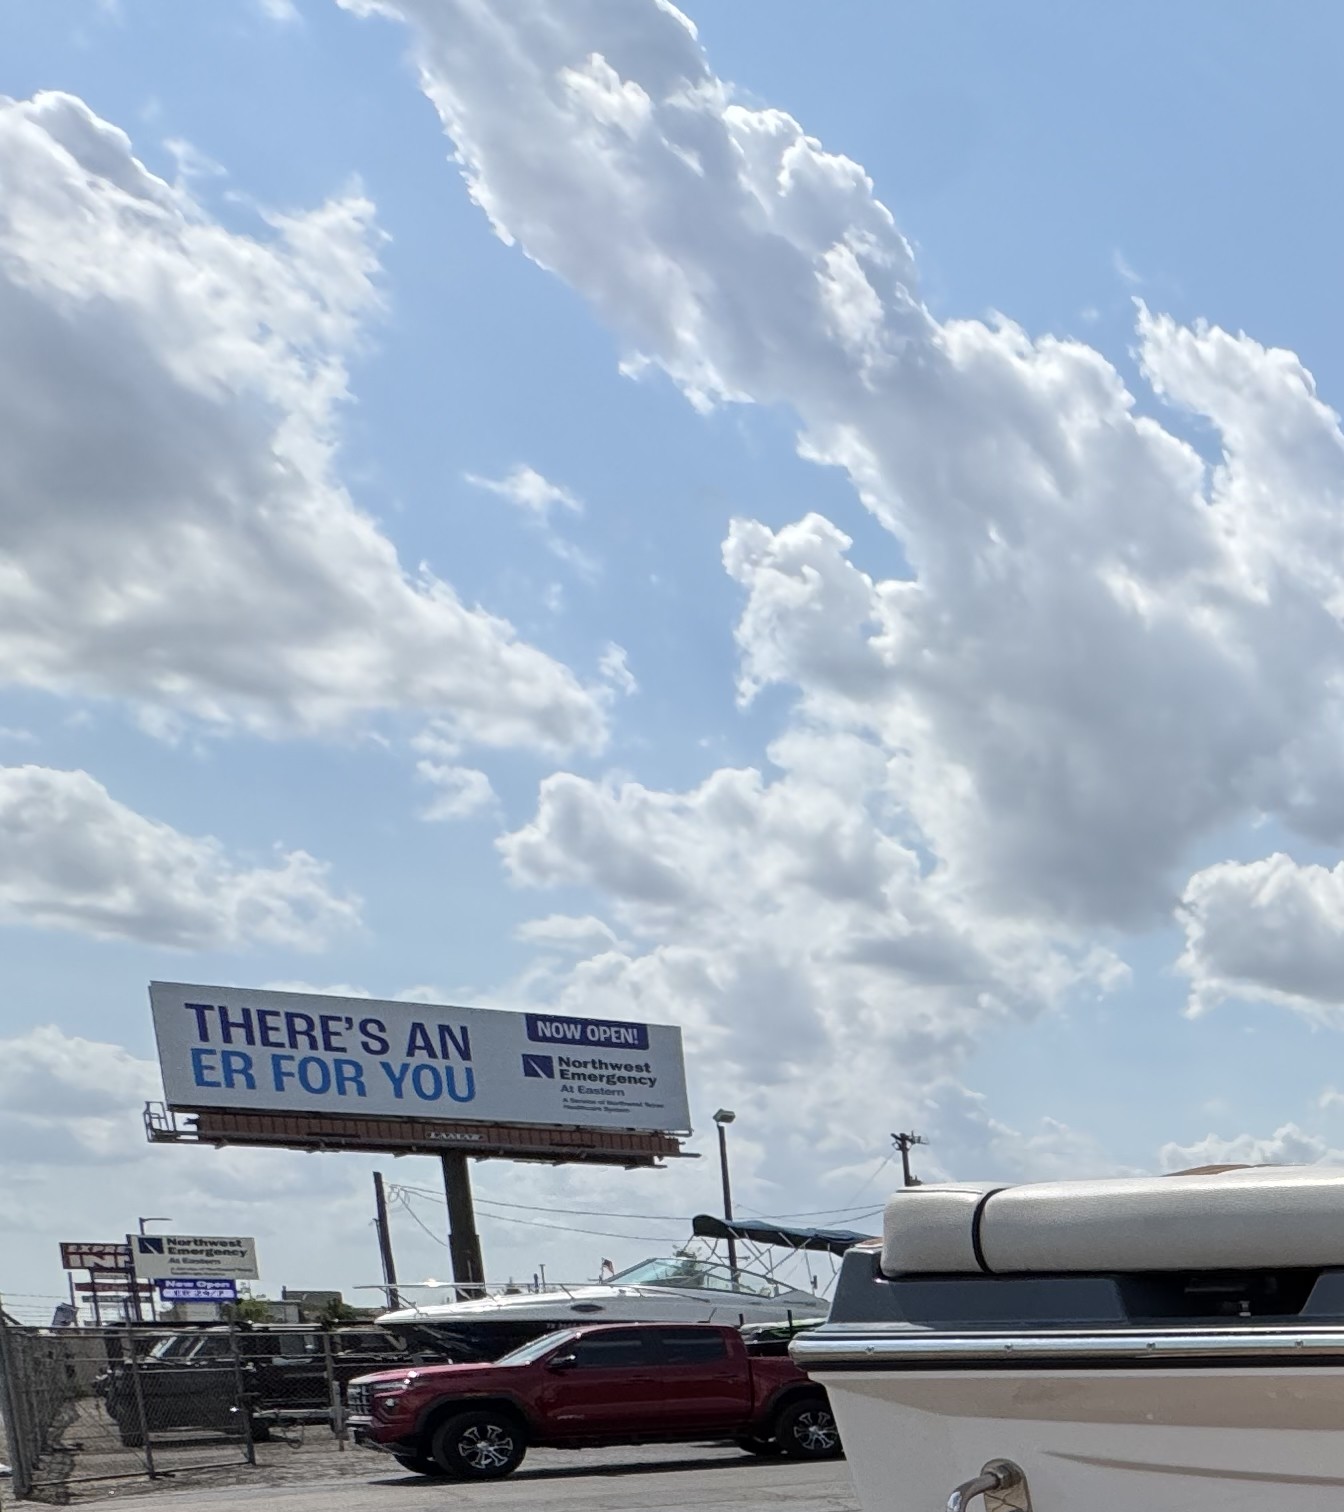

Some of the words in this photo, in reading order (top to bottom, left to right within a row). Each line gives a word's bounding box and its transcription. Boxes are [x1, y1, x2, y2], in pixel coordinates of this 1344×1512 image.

[184, 1002, 391, 1057] THERE'S
[406, 1021, 473, 1062] AN
[536, 1020, 581, 1040] NOW
[587, 1025, 640, 1045] OPEN!
[189, 1047, 257, 1091] ER
[273, 1053, 367, 1098] FOR
[380, 1060, 477, 1102] YOU
[557, 1056, 652, 1074] Northwest
[559, 1068, 657, 1088] Emergency
[560, 1084, 575, 1094] At
[577, 1085, 626, 1097] Eastern
[166, 1237, 242, 1249] Northwest
[167, 1246, 249, 1258] Emergency
